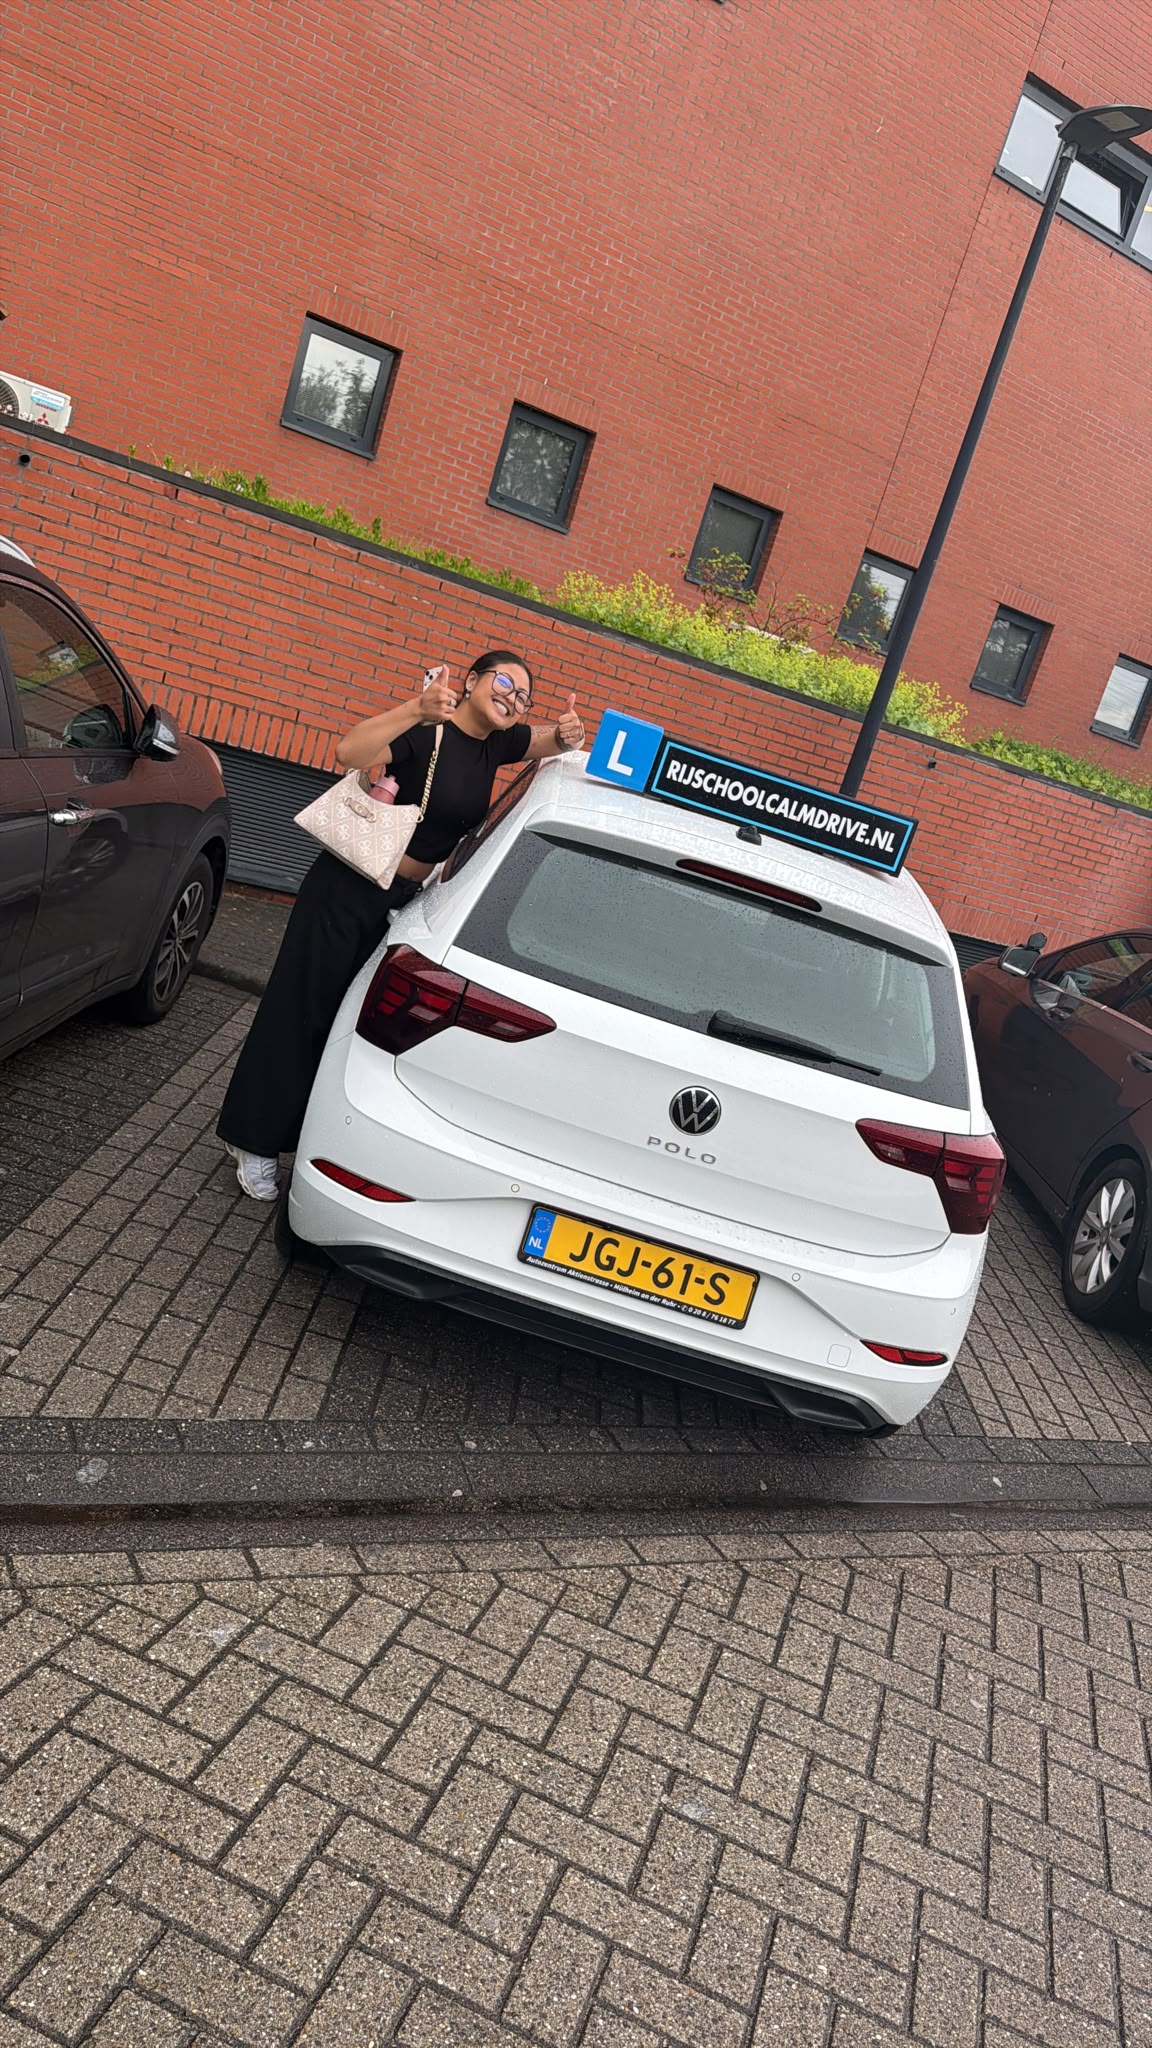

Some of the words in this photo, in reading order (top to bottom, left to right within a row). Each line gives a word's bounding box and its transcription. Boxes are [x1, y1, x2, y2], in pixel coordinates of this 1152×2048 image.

[606, 729, 634, 777] L
[665, 759, 896, 853] RIJSCHOOLCALMDRIVE.NL
[647, 1135, 717, 1165] POLO
[528, 1235, 544, 1250] NL
[526, 1256, 568, 1274] Autozentrum
[567, 1269, 610, 1287] Aktienstrasse
[613, 1283, 641, 1297] Mülheim
[640, 1292, 650, 1300] an
[649, 1294, 661, 1303] der
[661, 1298, 677, 1308] Ruhr
[568, 1231, 731, 1306] JGJ-61-S
